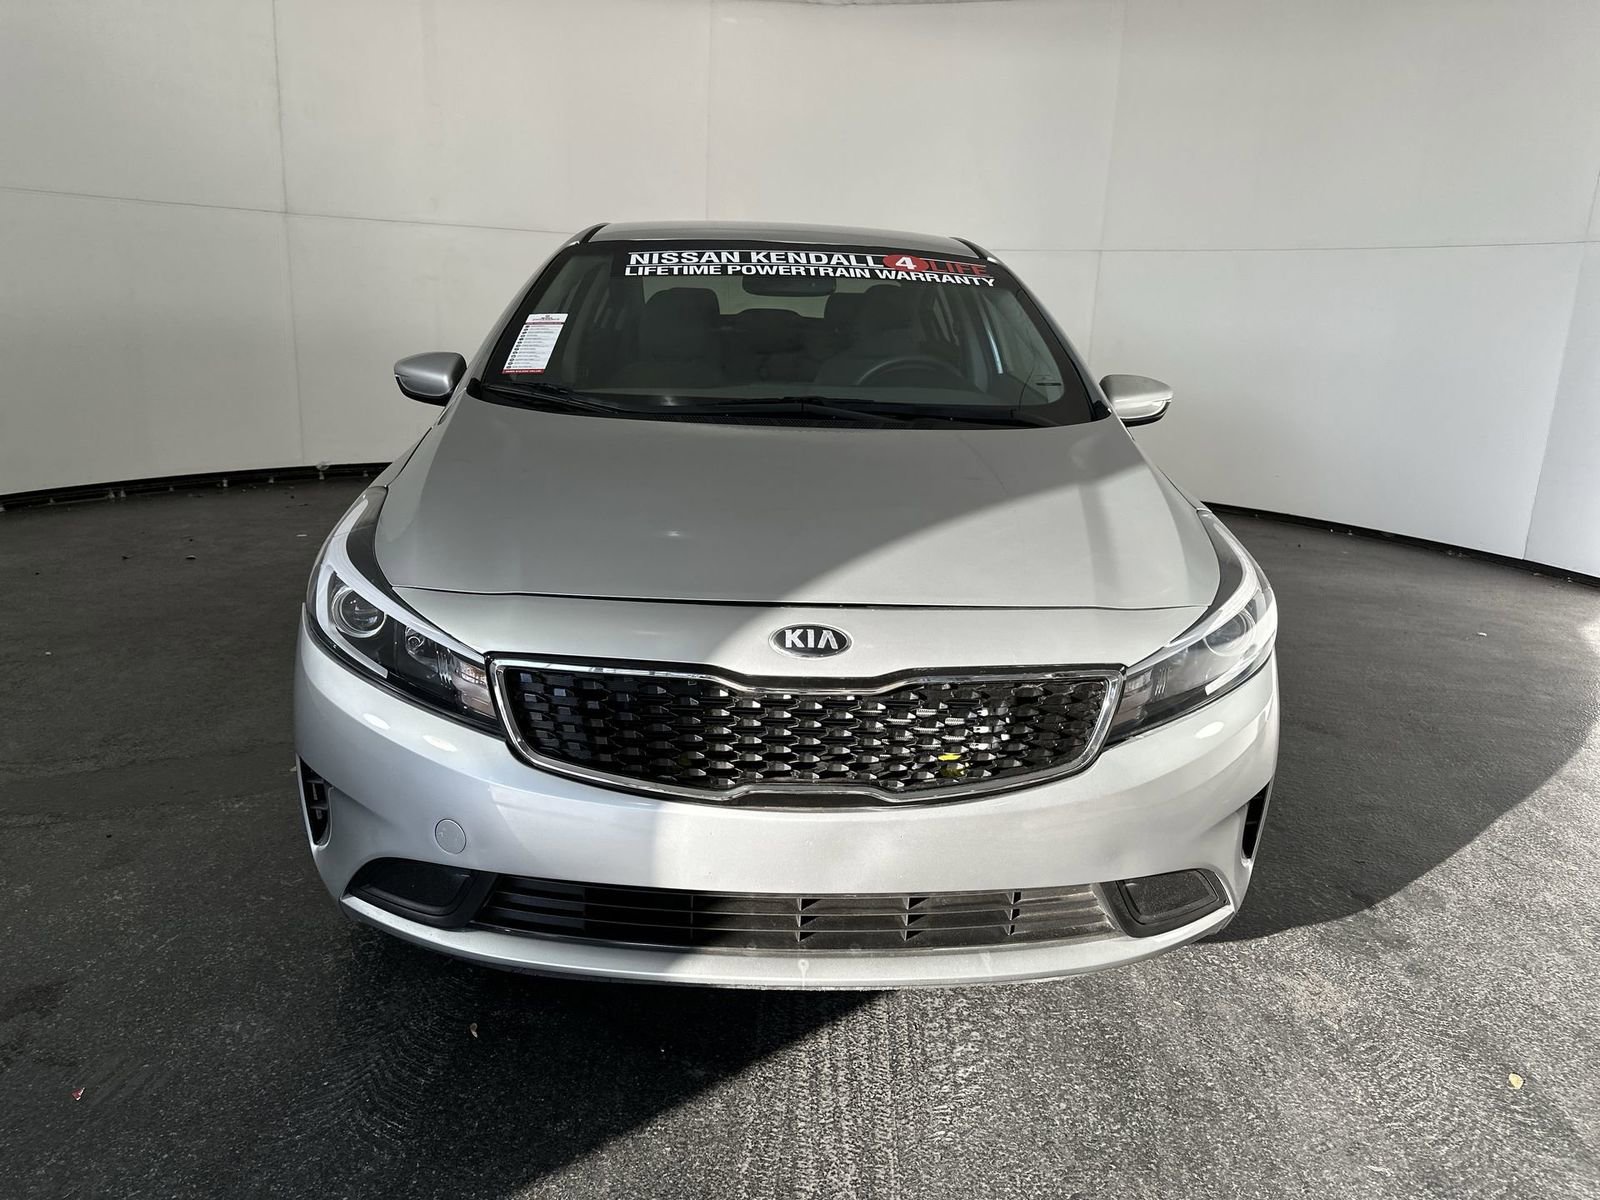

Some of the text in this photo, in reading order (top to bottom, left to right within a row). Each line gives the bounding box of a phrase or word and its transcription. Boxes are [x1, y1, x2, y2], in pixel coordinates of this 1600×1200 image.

[629, 251, 988, 276] NISSAN KENDALL 4 LIFE
[624, 265, 996, 287] LIFETIME POWERTRAIN WARRANTY
[785, 629, 839, 650] KIA
